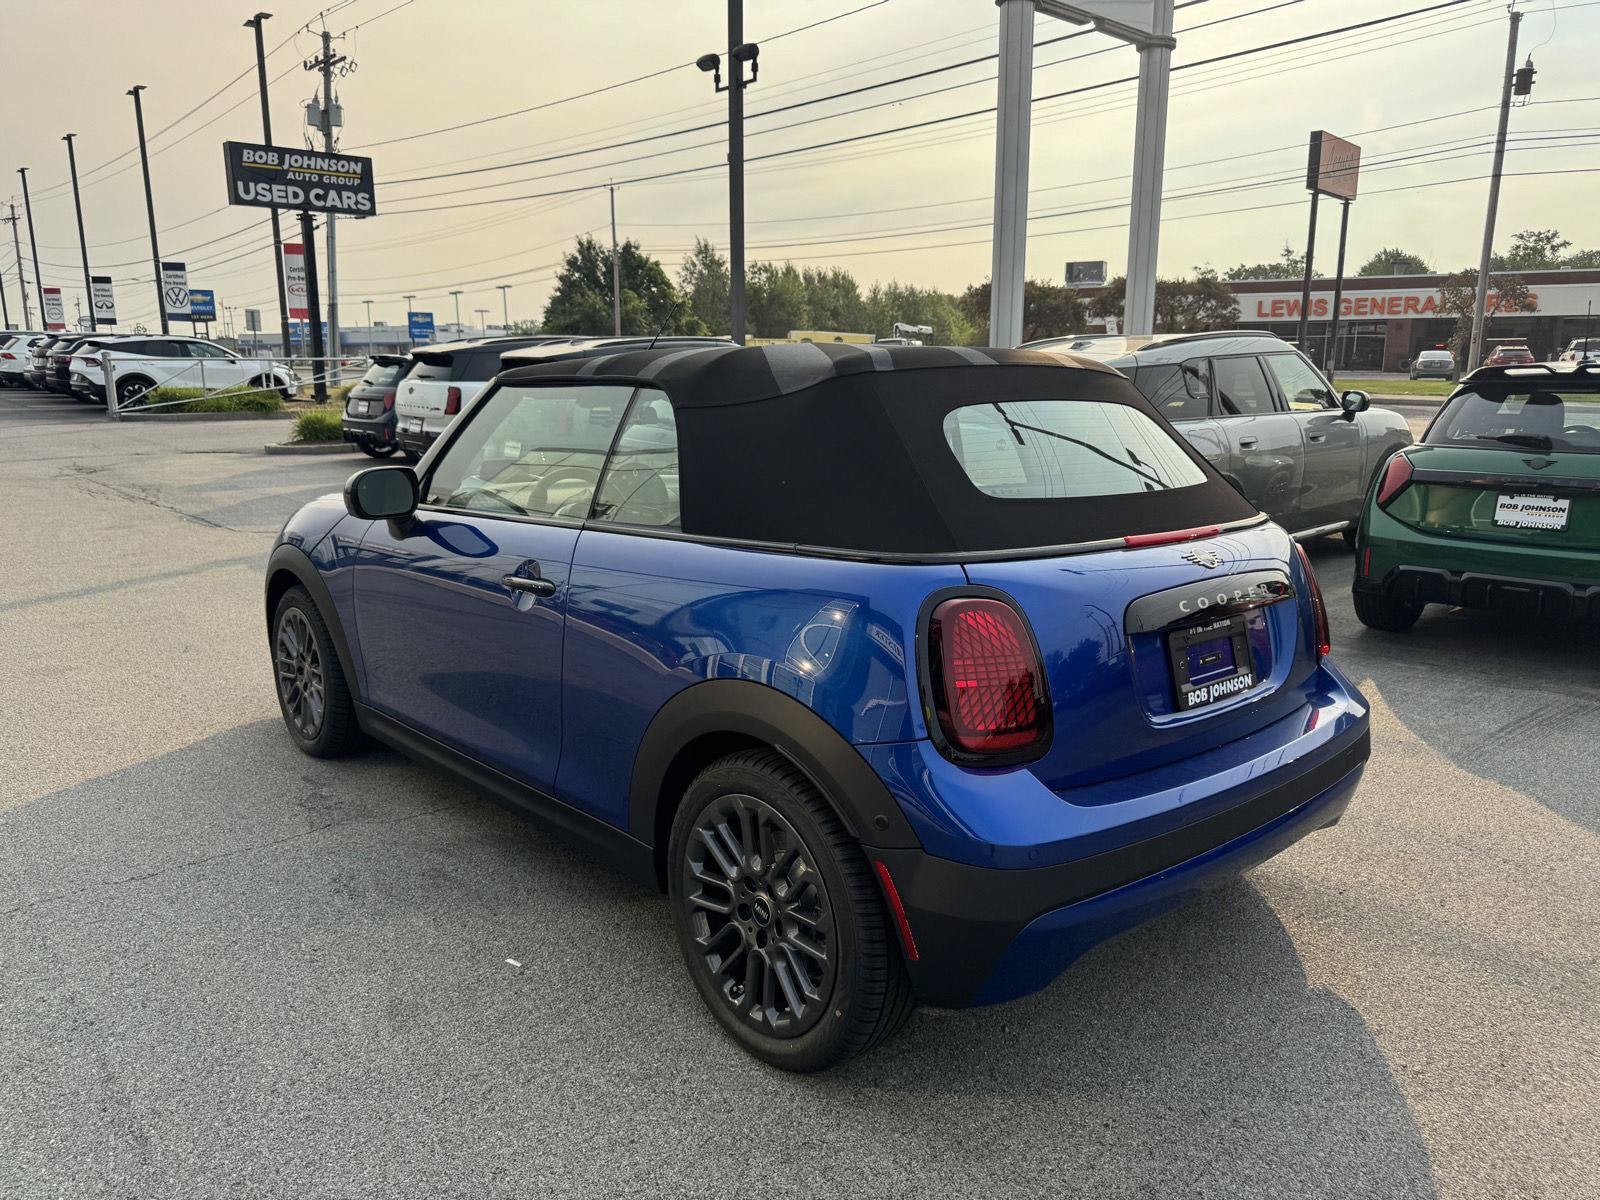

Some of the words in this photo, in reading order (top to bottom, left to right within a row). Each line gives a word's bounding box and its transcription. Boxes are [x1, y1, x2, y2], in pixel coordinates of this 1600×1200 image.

[242, 149, 279, 165] BOB
[282, 154, 362, 174] JOHNSON
[286, 171, 319, 182] AUTO
[322, 175, 361, 187] GROUP
[237, 181, 305, 204] USED
[309, 188, 372, 211] CARS
[1256, 298, 1328, 318] LEWIS
[1499, 502, 1520, 510] BOB
[1520, 504, 1567, 514] JOHNSON
[1497, 519, 1517, 527] BOB
[1516, 520, 1562, 530] JOHNSON
[1178, 583, 1270, 613] COOPER
[1187, 687, 1208, 706] BOB
[1209, 673, 1253, 703] JOHNSON
